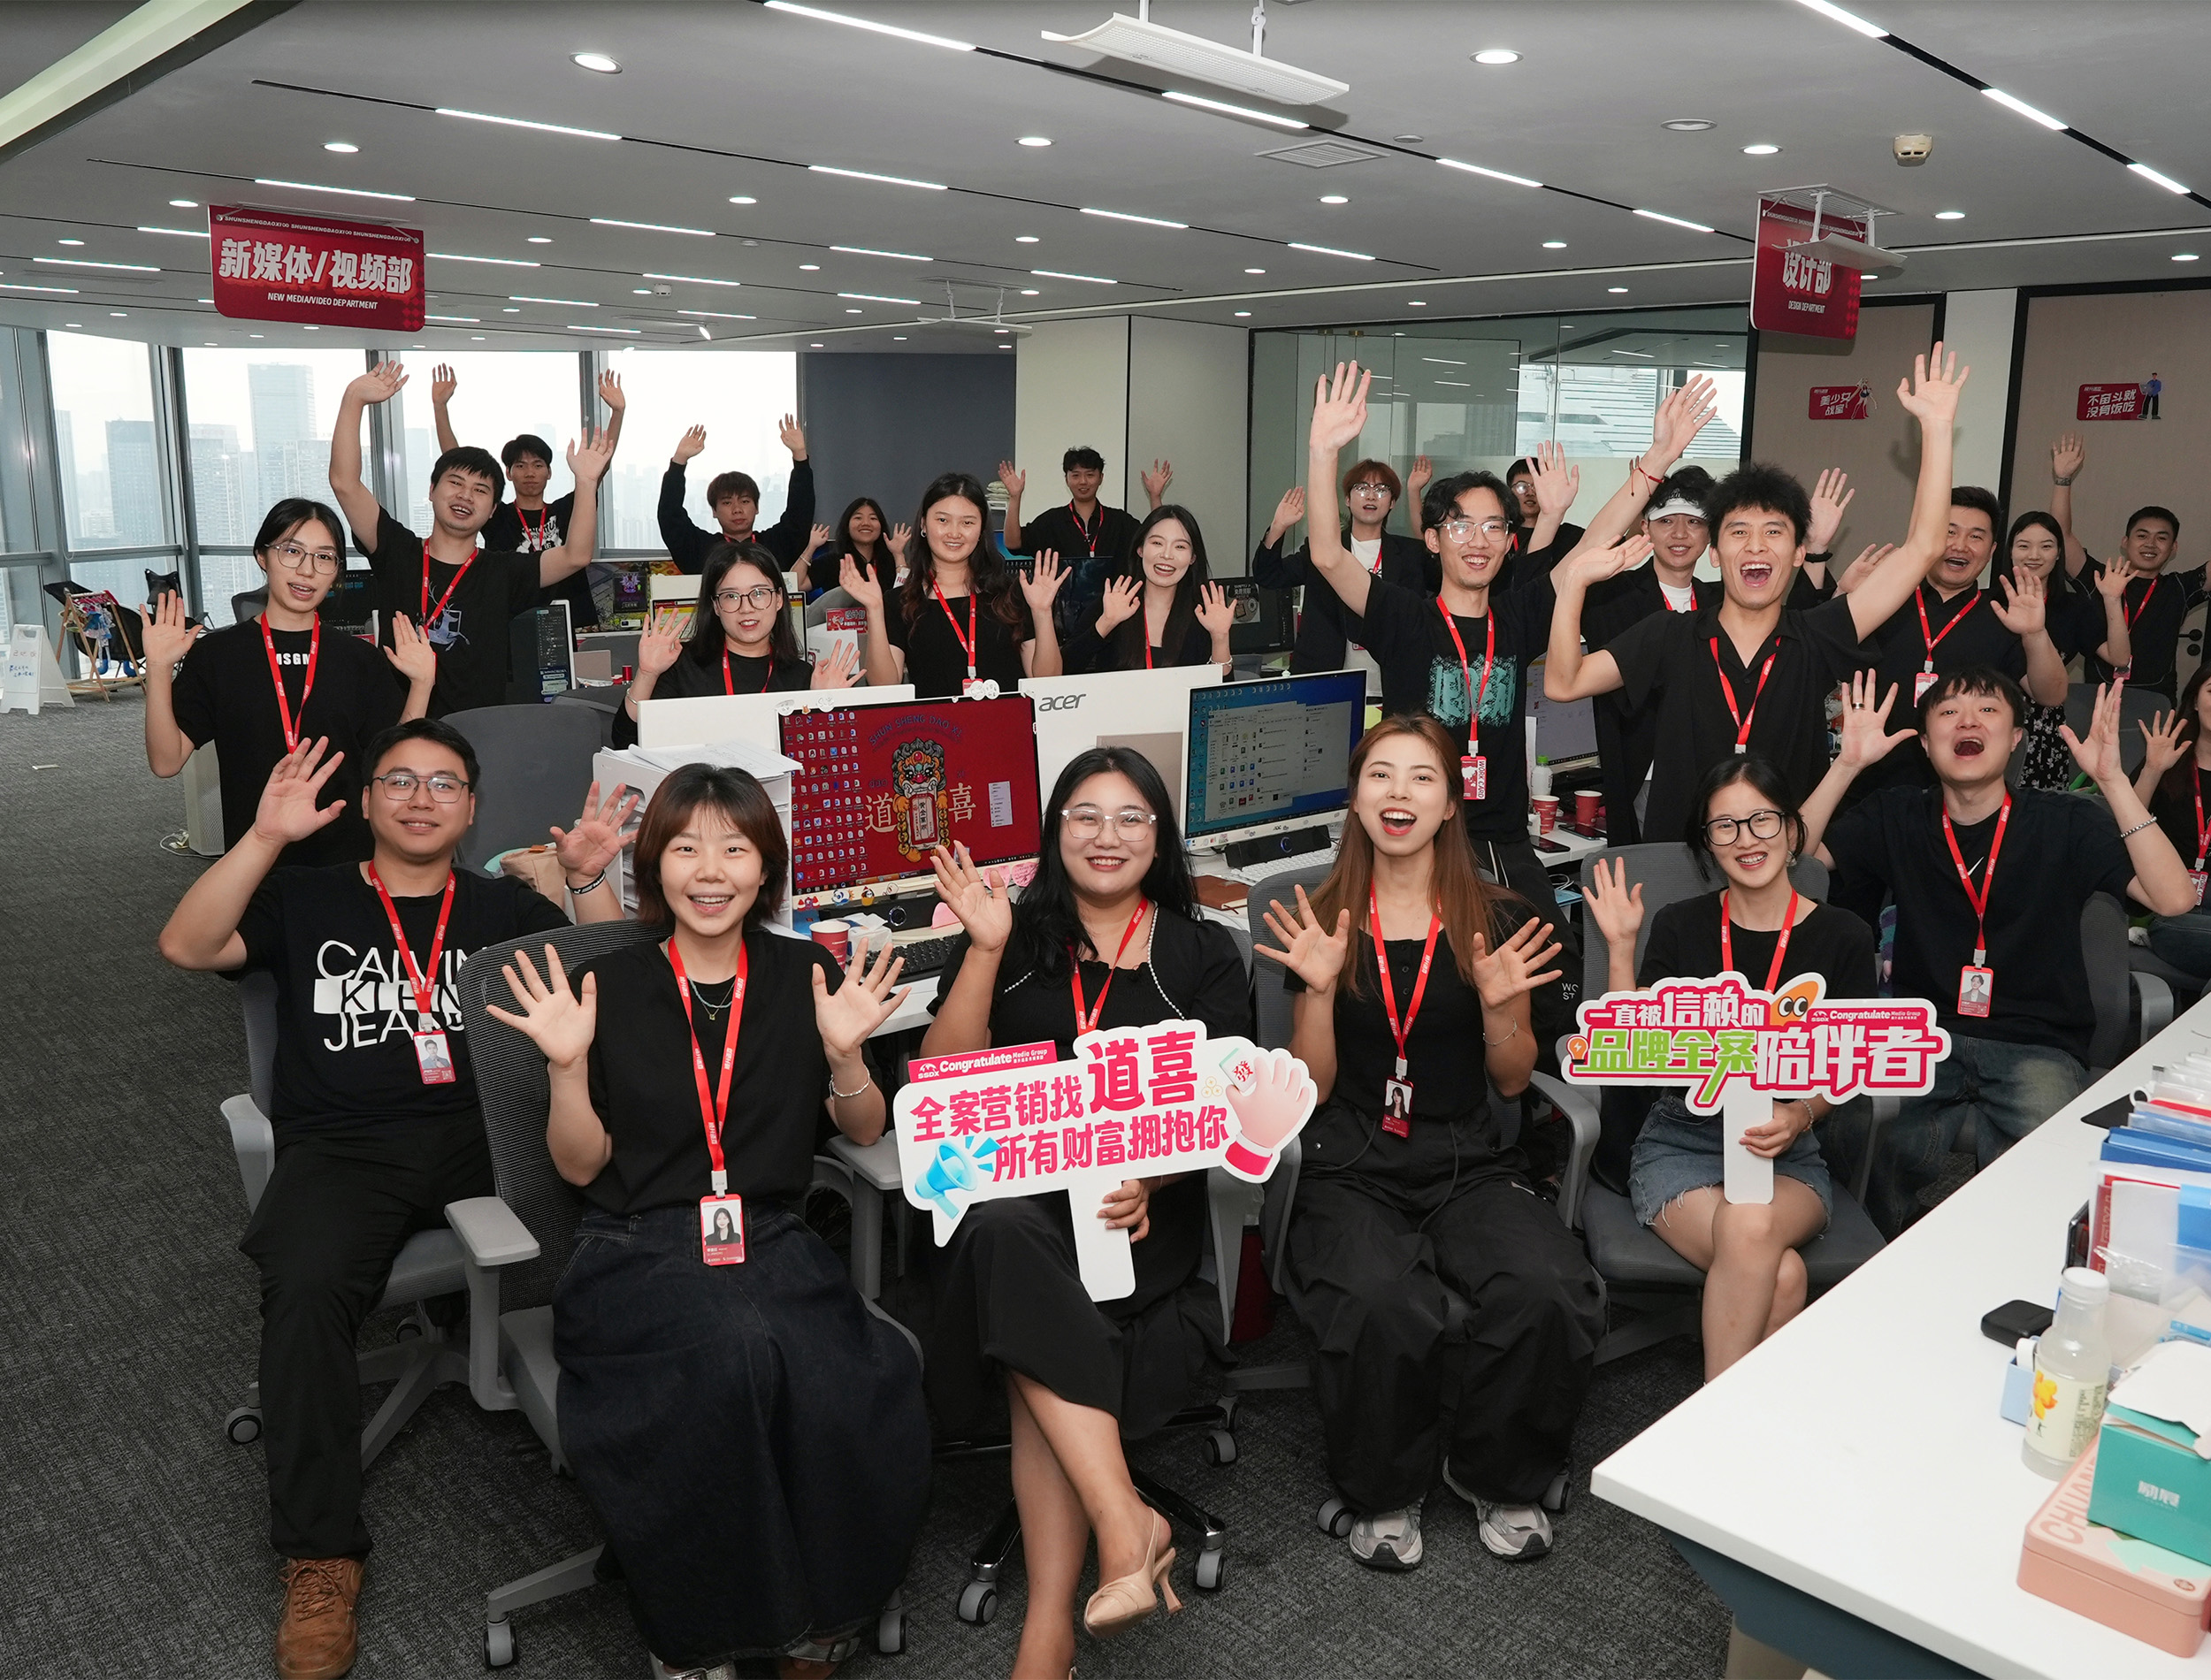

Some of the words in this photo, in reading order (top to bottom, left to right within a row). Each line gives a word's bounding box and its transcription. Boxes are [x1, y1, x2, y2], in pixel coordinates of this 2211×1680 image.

[218, 239, 413, 294] 新媒体/视频部
[1782, 251, 1832, 294] 设计部
[267, 292, 285, 302] NEW
[286, 294, 332, 306] MEDIA/VIDEO
[333, 297, 378, 309] DEPARTMENT
[1788, 300, 1802, 310] DESIGN
[1801, 302, 1825, 314] DEPARTMENT
[2086, 401, 2136, 418] 没有饭吃
[1038, 694, 1086, 712] acer
[868, 723, 892, 745] SHUN
[895, 714, 926, 729] SHENG
[929, 715, 950, 729] DAO
[952, 726, 962, 737] XI
[865, 792, 897, 833] 道
[948, 783, 976, 823] 喜
[1589, 984, 1765, 1027] 一直被信赖的
[1830, 1009, 1891, 1022] Congratulate
[917, 1070, 939, 1080] SSDX
[939, 1053, 1013, 1073] Congratulate
[910, 1030, 1197, 1142] 全案营销找道喜
[991, 1104, 1230, 1182] 所有财富拥抱你
